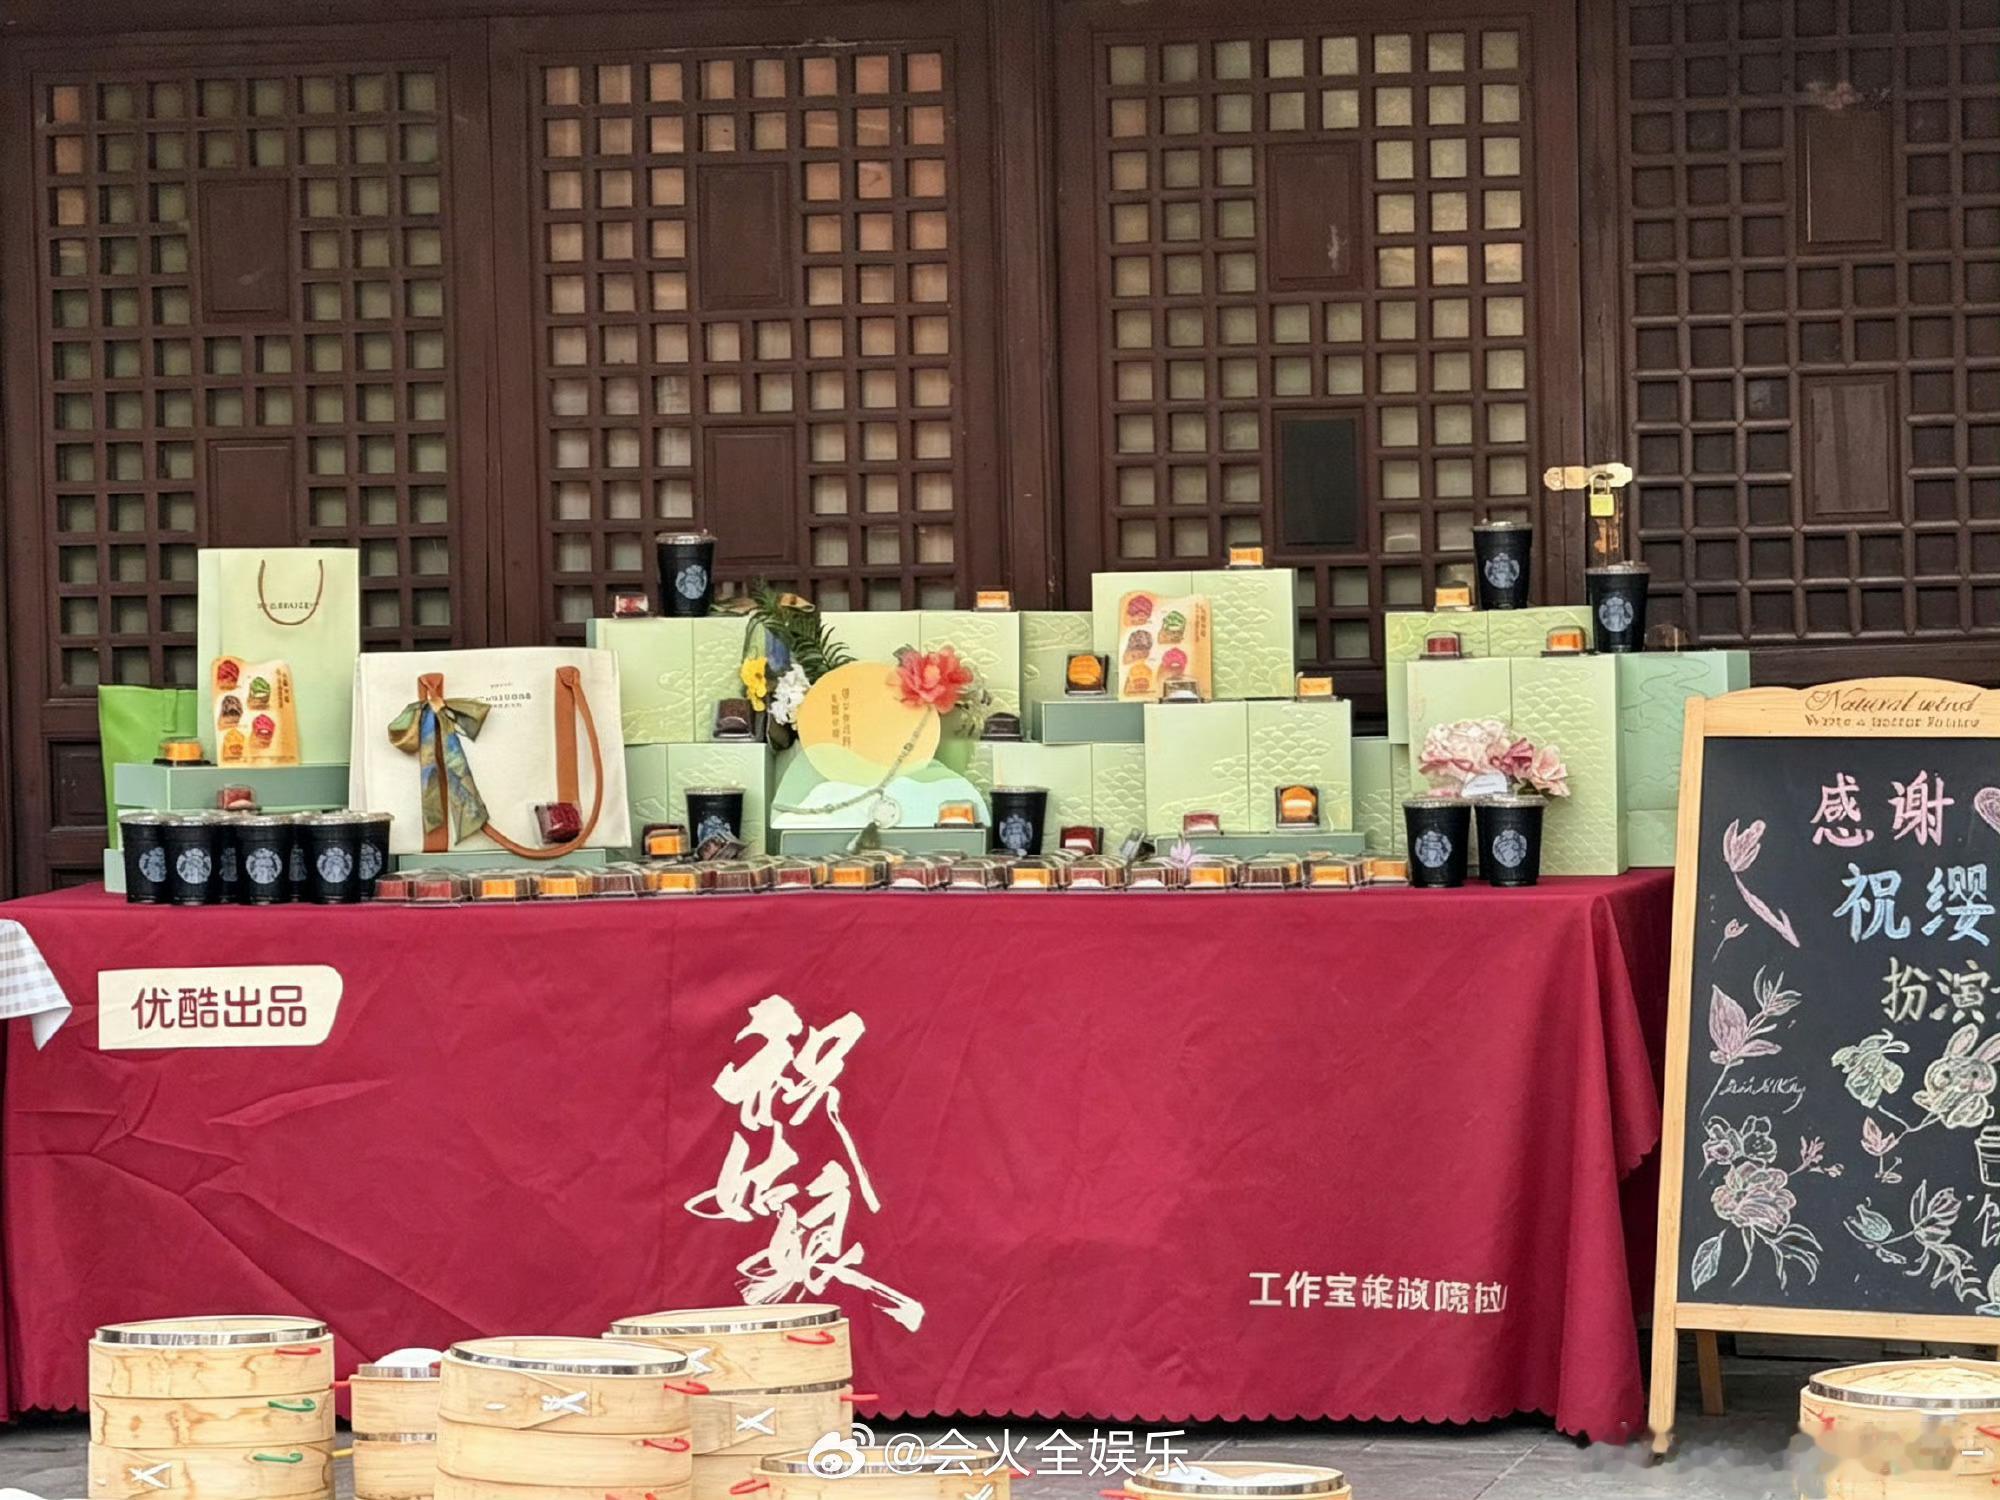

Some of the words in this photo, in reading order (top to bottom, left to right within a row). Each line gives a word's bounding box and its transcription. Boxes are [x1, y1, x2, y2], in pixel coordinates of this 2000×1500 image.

[1805, 687, 1918, 713] Natural
[1810, 770, 1954, 847] 感谢
[1832, 862, 1996, 946] 祝缨
[131, 985, 307, 1030] 优酷出品
[1880, 956, 2000, 1024] 扮演
[684, 994, 925, 1333] 祝姑娘
